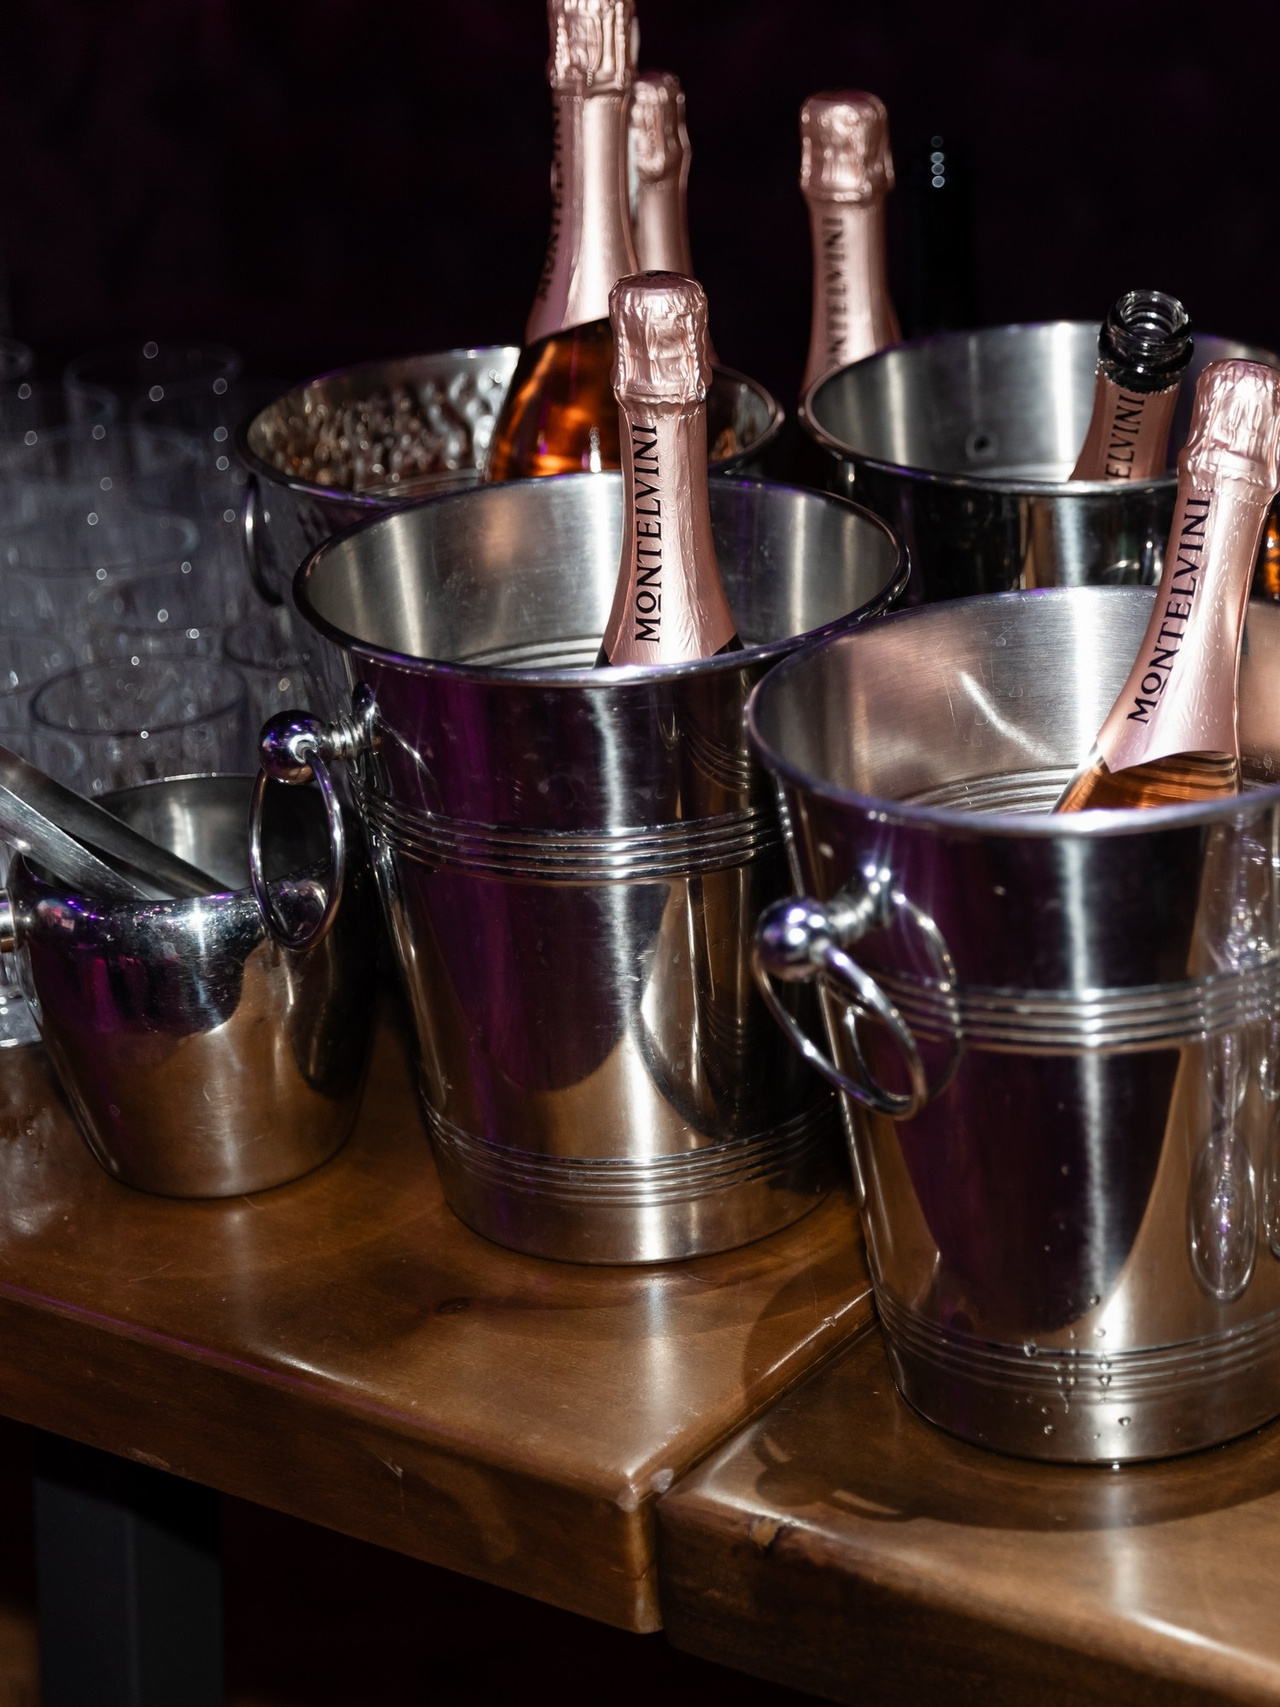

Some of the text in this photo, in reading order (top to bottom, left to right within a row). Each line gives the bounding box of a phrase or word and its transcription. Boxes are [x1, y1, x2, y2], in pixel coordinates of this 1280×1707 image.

[634, 423, 663, 643] MONTELVINI
[1104, 394, 1146, 480] ELVINI
[1126, 497, 1212, 725] MONTELVINI
